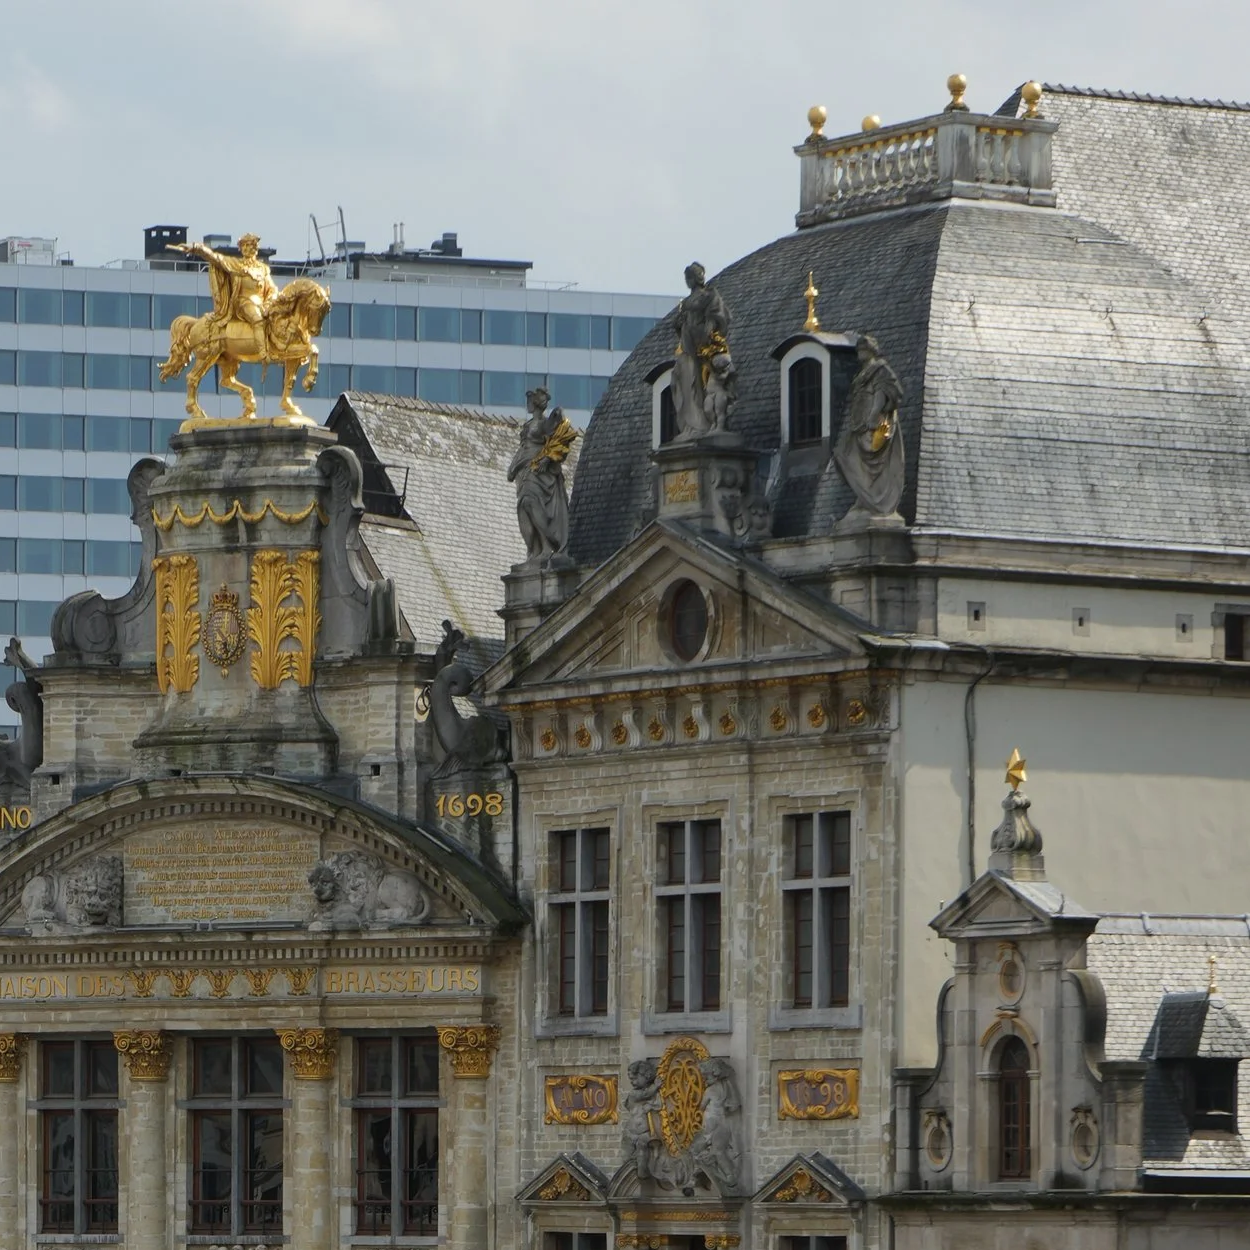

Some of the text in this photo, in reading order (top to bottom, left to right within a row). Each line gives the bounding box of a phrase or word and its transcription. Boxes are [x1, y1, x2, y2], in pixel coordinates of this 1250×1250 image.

[436, 793, 504, 817] 1698
[75, 974, 127, 998] DES
[325, 967, 480, 993] BRASSEURS
